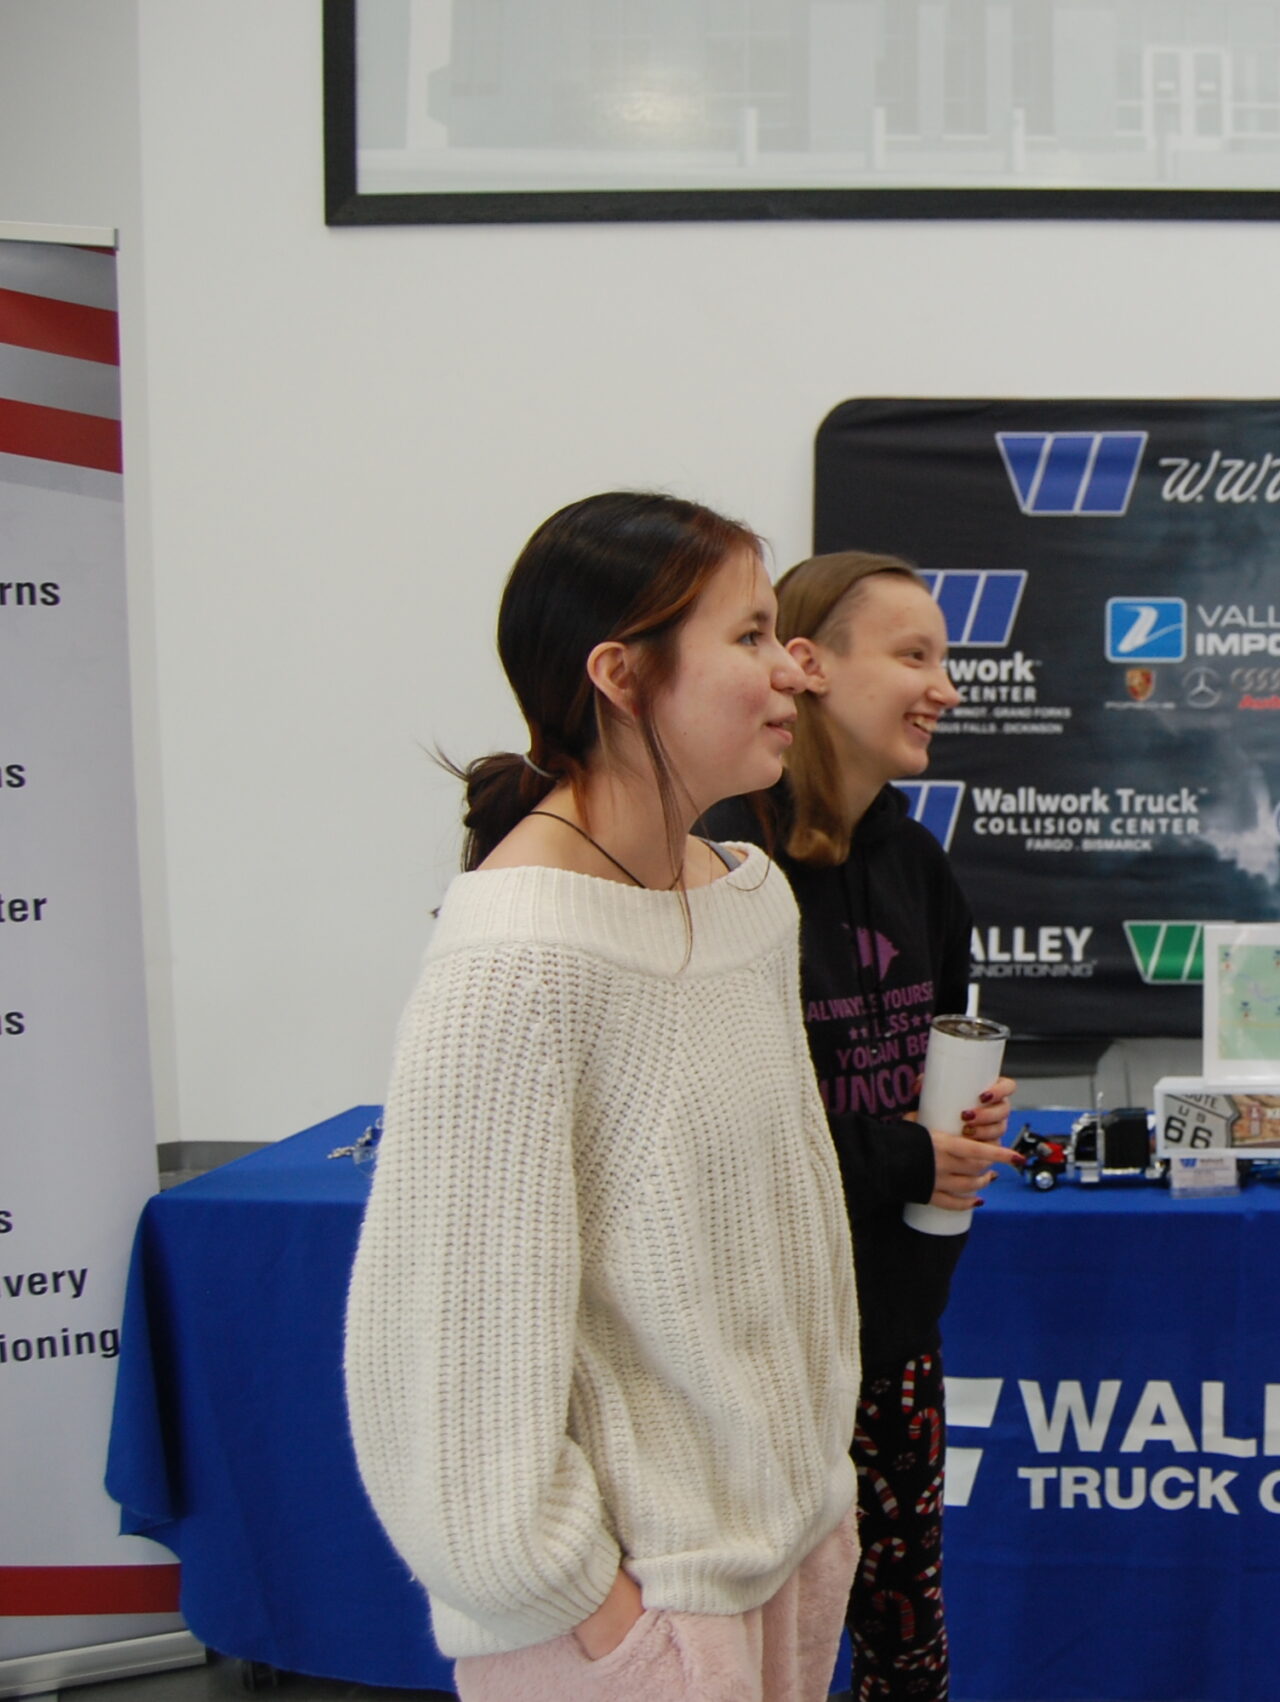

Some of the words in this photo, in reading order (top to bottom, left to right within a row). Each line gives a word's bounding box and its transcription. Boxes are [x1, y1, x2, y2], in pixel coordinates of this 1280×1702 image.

[941, 651, 1035, 682] work
[959, 686, 1037, 702] CENTER
[972, 787, 1110, 814] Wallwork
[1116, 788, 1199, 814] Truck
[973, 817, 1100, 835] COLLISION
[1110, 817, 1200, 835] CENTER
[1025, 839, 1073, 851] FARGO
[1083, 839, 1153, 851] BISMARCK
[820, 1064, 926, 1114] UNCO
[1018, 1466, 1240, 1515] TRUCK
